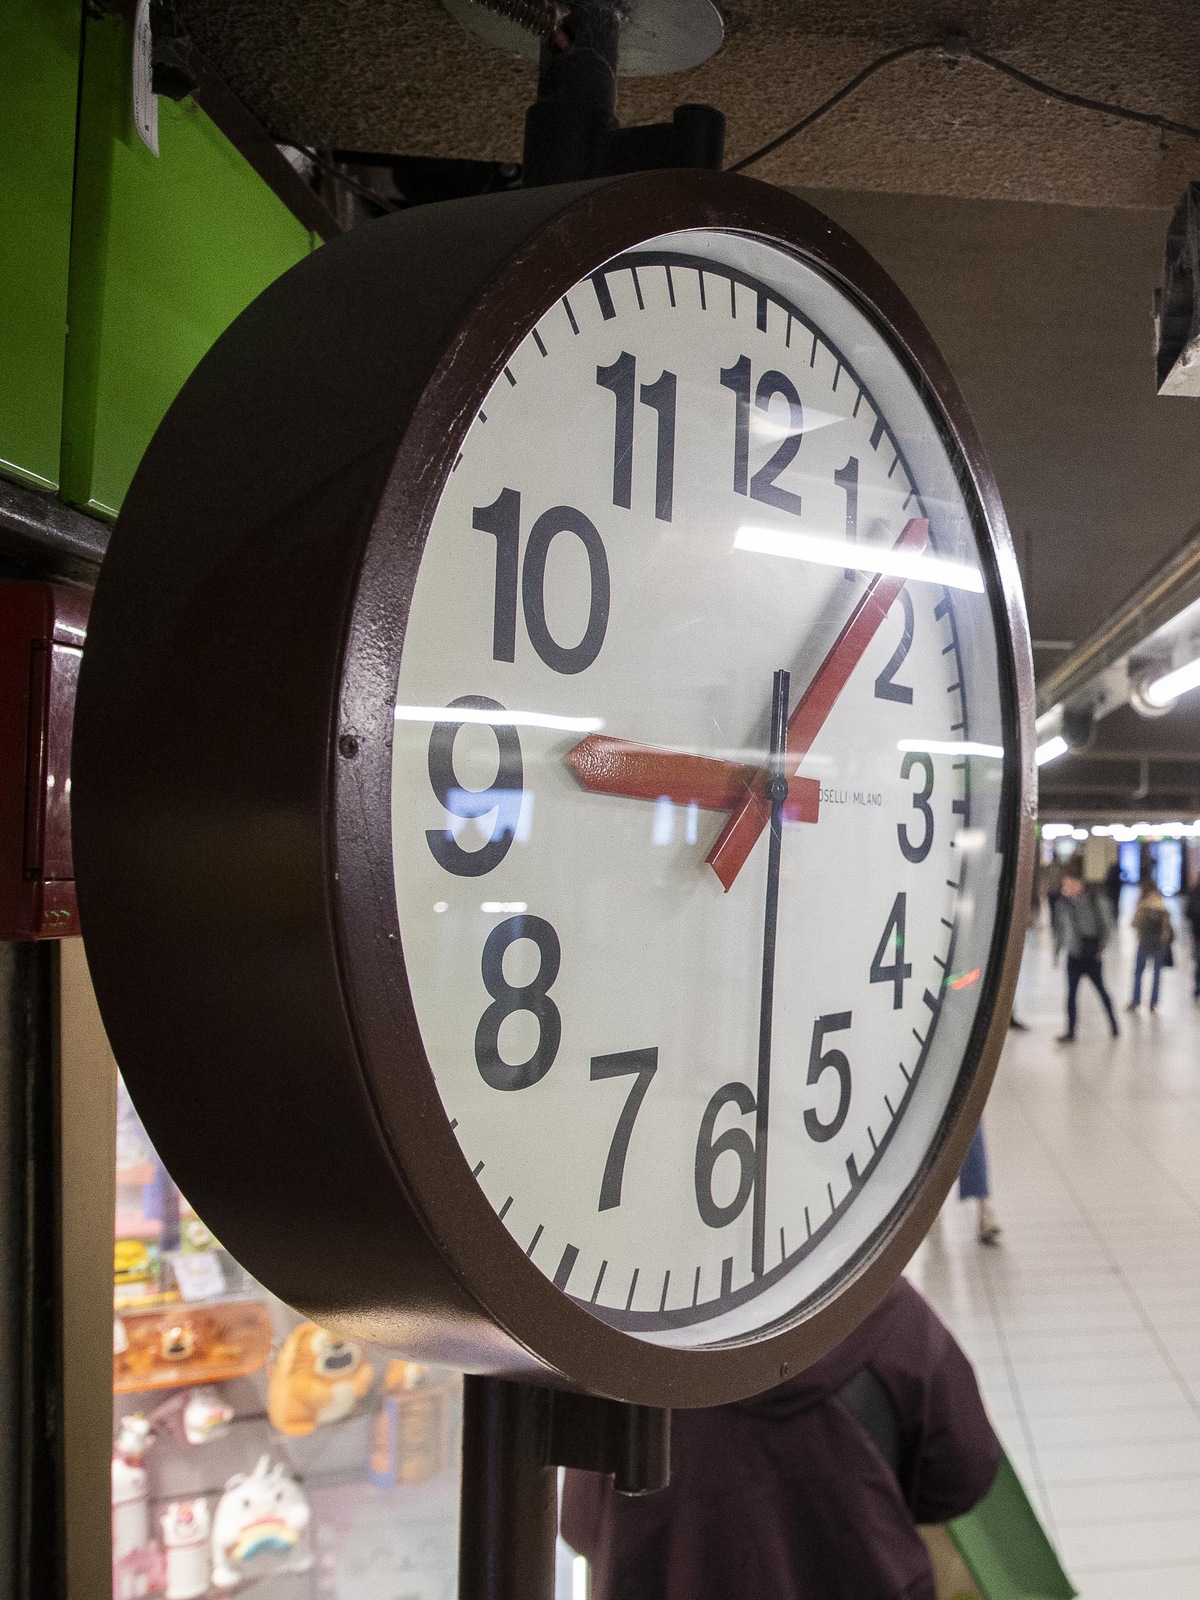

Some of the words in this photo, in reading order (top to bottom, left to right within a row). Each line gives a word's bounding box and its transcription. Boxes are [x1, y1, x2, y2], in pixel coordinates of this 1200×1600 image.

[596, 351, 677, 523] 11
[720, 354, 804, 517] 12
[472, 487, 611, 675] 10
[834, 455, 859, 582] 1
[874, 584, 915, 705] 2
[425, 694, 524, 878] 9
[819, 788, 848, 804] OSELLI
[897, 751, 935, 863] 3
[474, 914, 562, 1092] 8
[869, 892, 912, 1010] 4
[590, 1046, 659, 1213] 7
[803, 1011, 852, 1143] 5
[694, 1081, 759, 1230] 6
